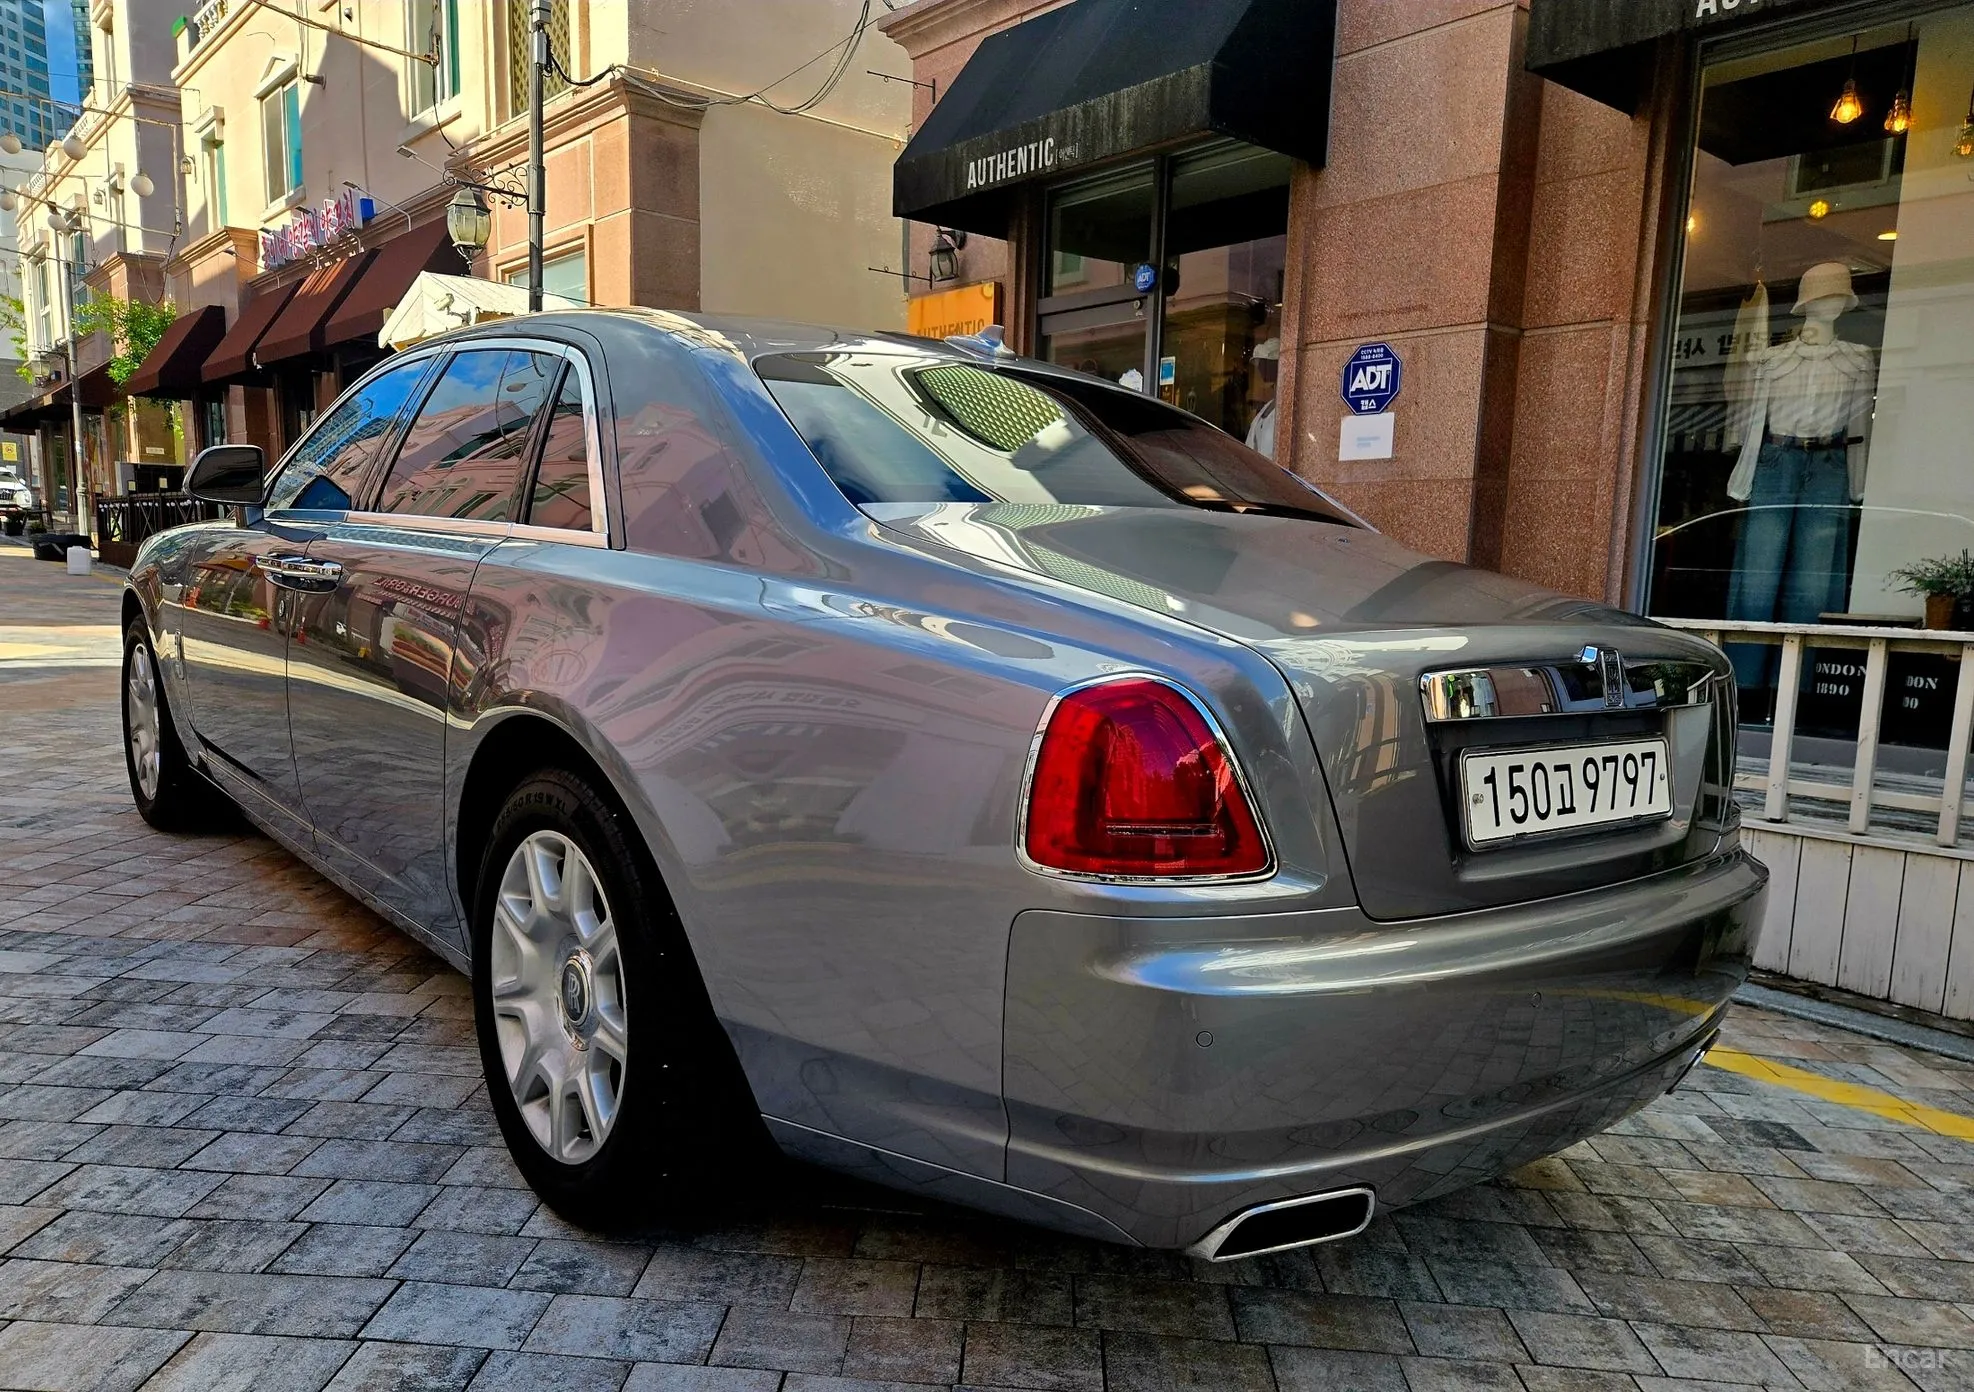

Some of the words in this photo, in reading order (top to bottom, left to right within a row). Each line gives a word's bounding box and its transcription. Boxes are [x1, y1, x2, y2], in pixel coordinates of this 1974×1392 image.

[967, 137, 1054, 189] AUTHENTIC
[1350, 364, 1392, 392] ADT
[1816, 682, 1850, 697] 1890
[1582, 751, 1656, 813] 9797
